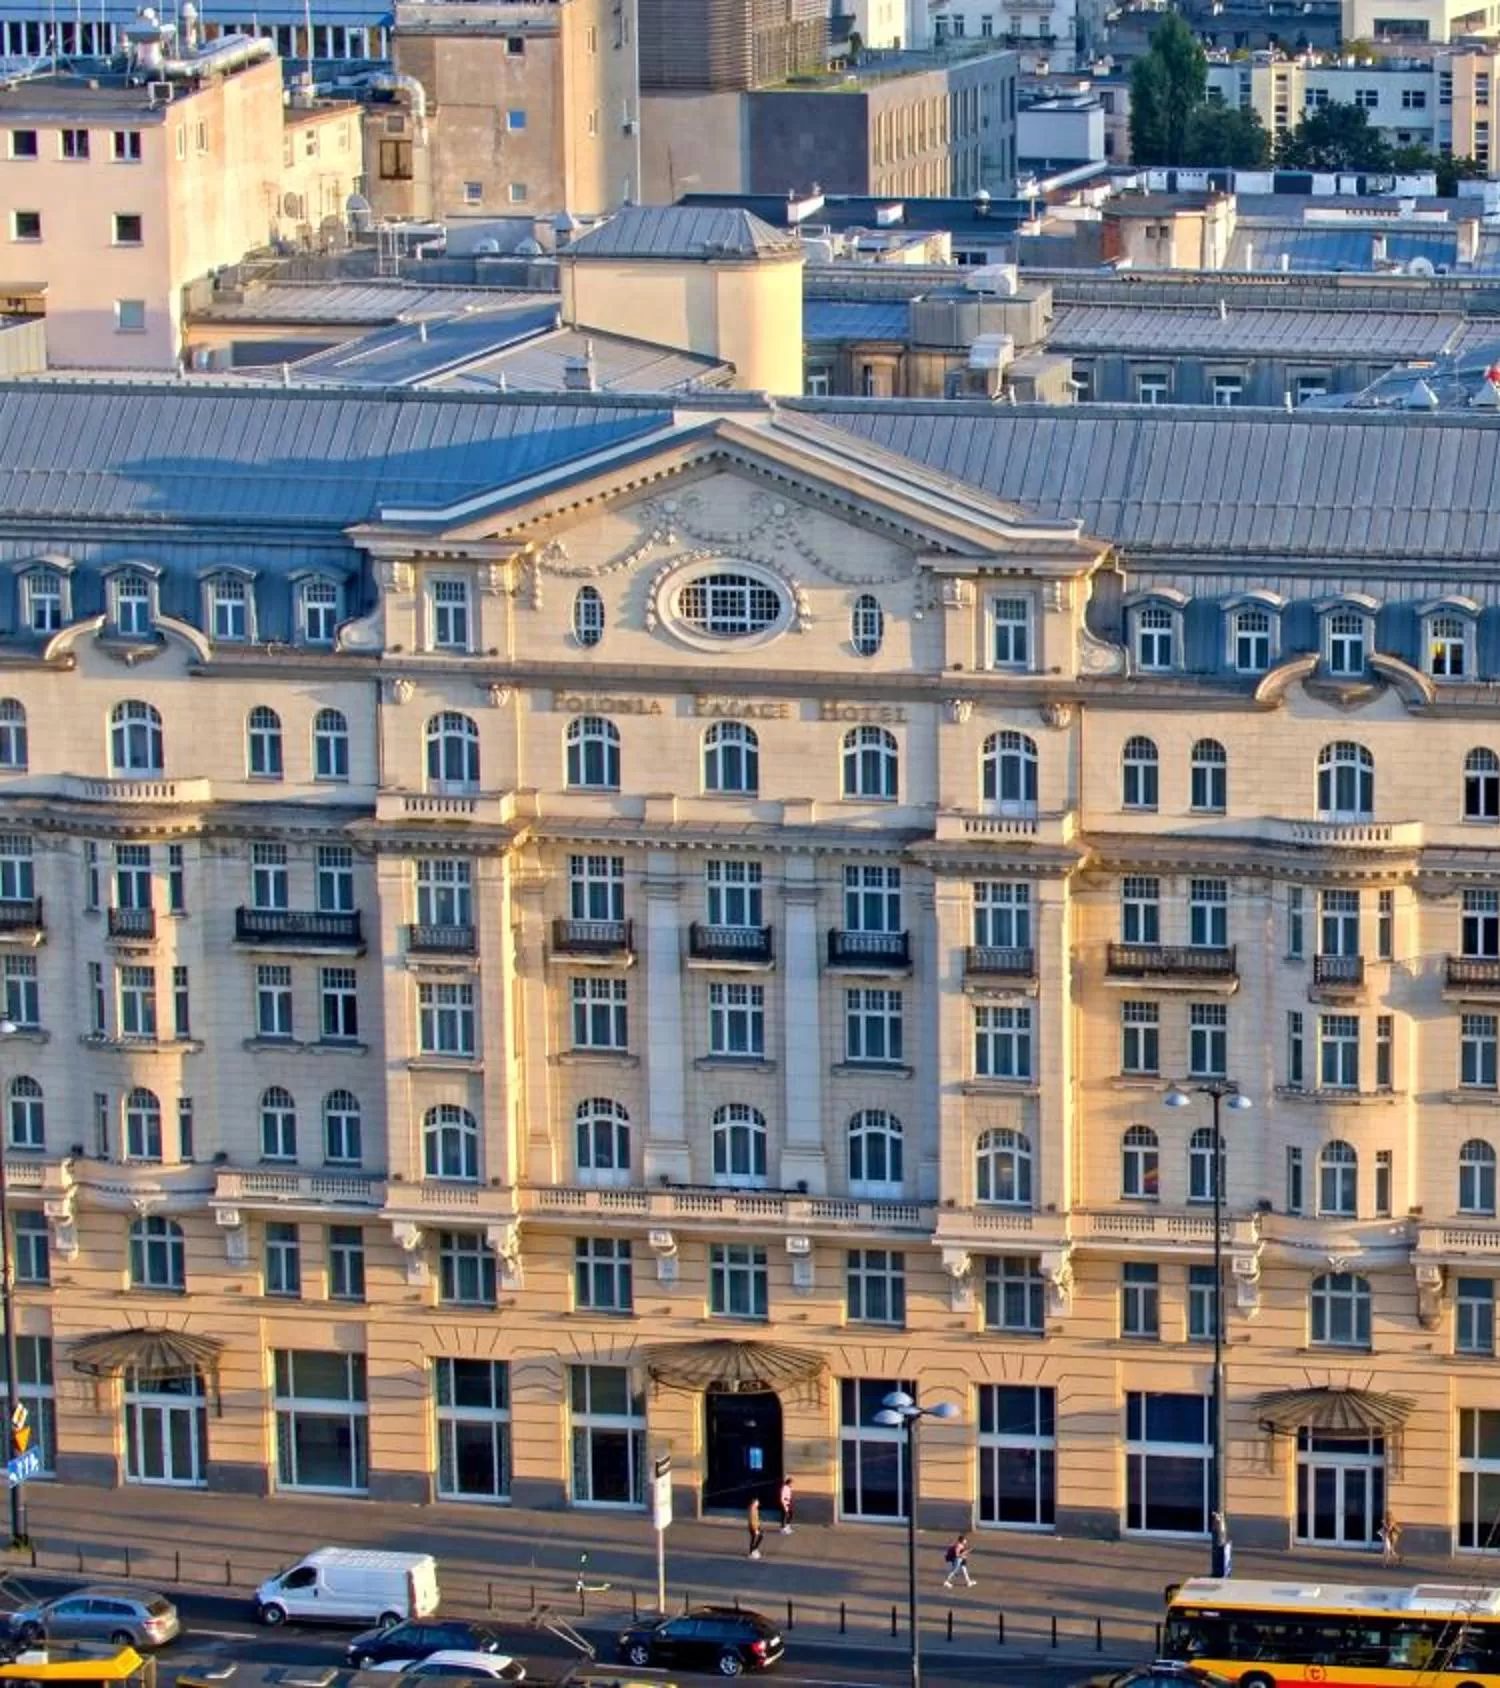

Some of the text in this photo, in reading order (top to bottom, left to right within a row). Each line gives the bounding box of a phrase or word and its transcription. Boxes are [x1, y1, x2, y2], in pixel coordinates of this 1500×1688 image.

[552, 689, 908, 723] POLONIA PALACE HOTEL
